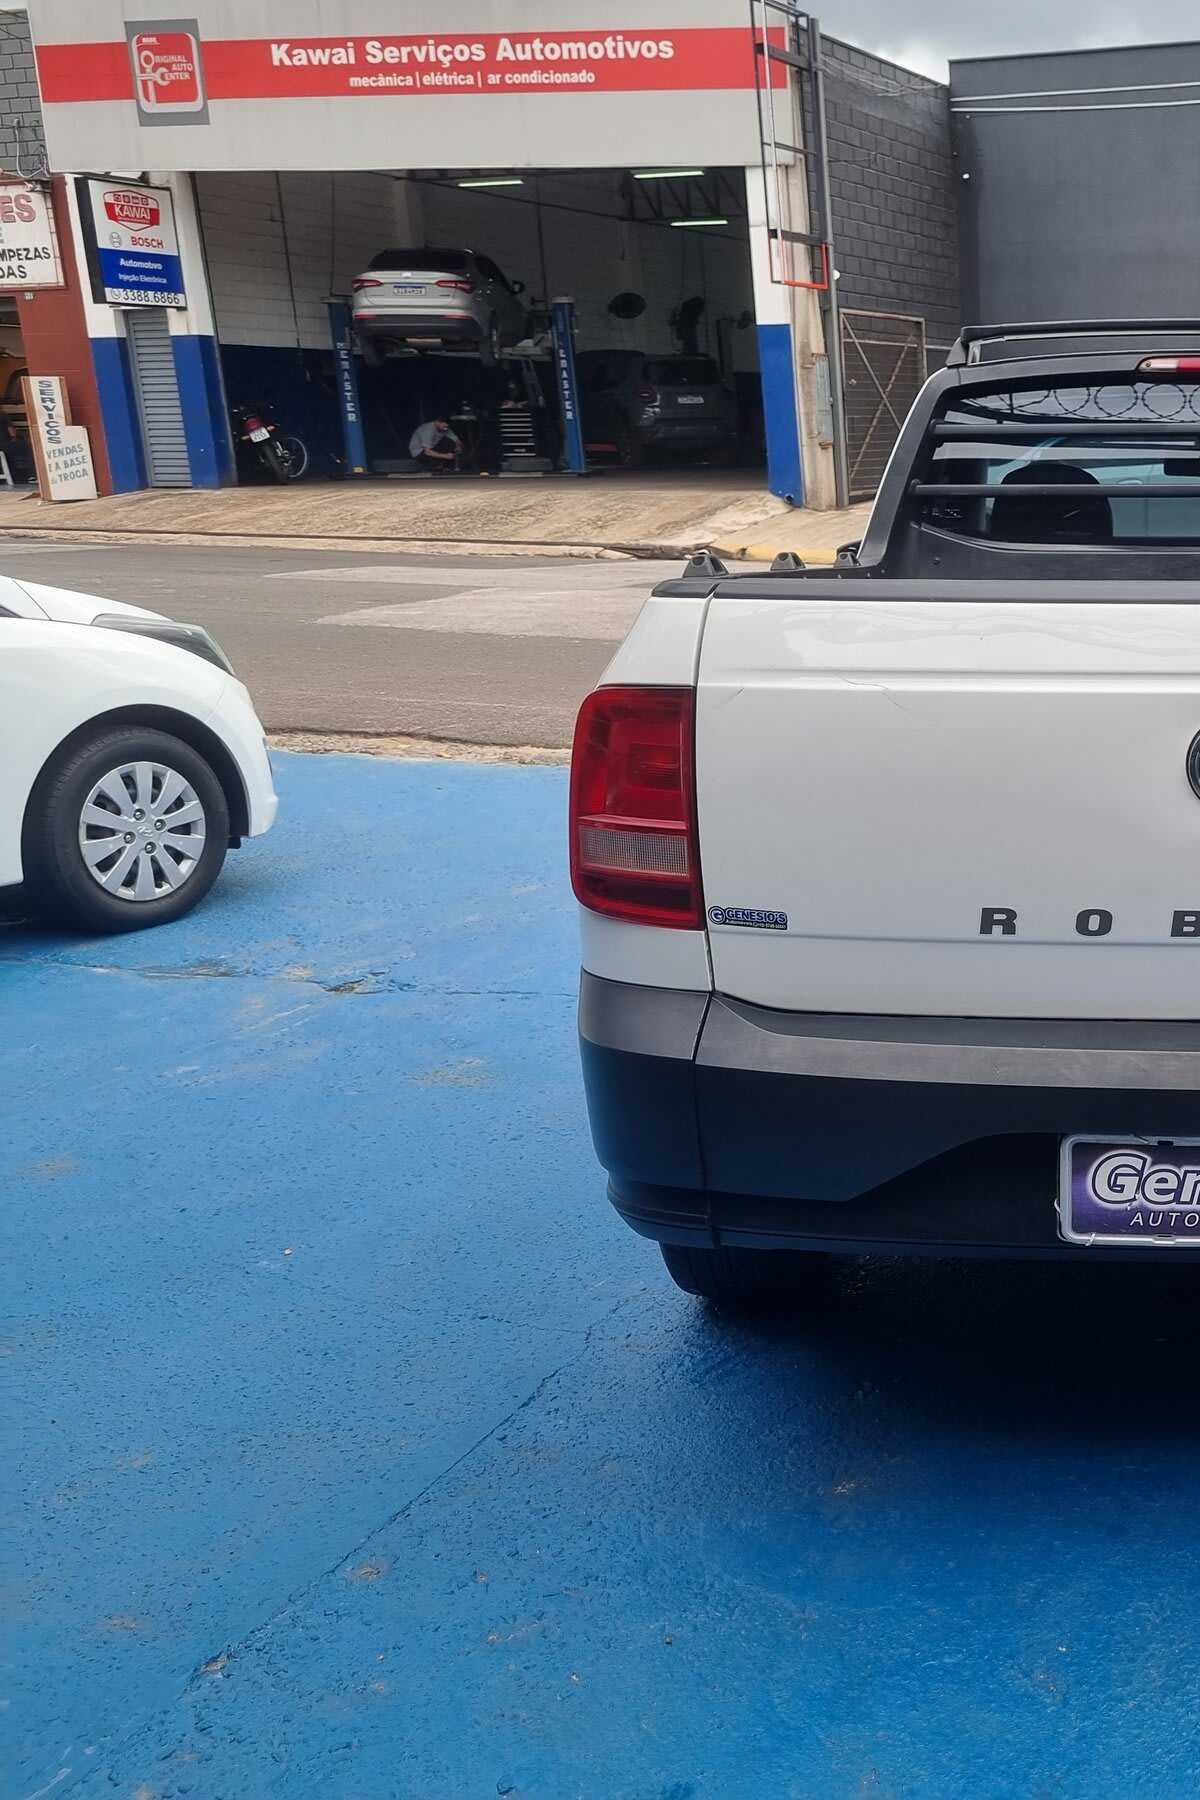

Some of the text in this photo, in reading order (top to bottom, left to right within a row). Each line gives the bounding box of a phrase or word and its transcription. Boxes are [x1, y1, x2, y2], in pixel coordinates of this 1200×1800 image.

[271, 35, 675, 68] Kawai Serviços Automotivos
[171, 63, 193, 72] AUTO
[349, 69, 596, 87] mecânica elétrica ar condicionado
[114, 204, 151, 220] KAWAI
[130, 236, 164, 249] BOSCH
[120, 258, 163, 270] Automotivo
[122, 288, 180, 305] 3388.6866
[46, 444, 84, 460] VENDAS
[64, 455, 88, 469] BASE
[58, 468, 89, 483] TROCA
